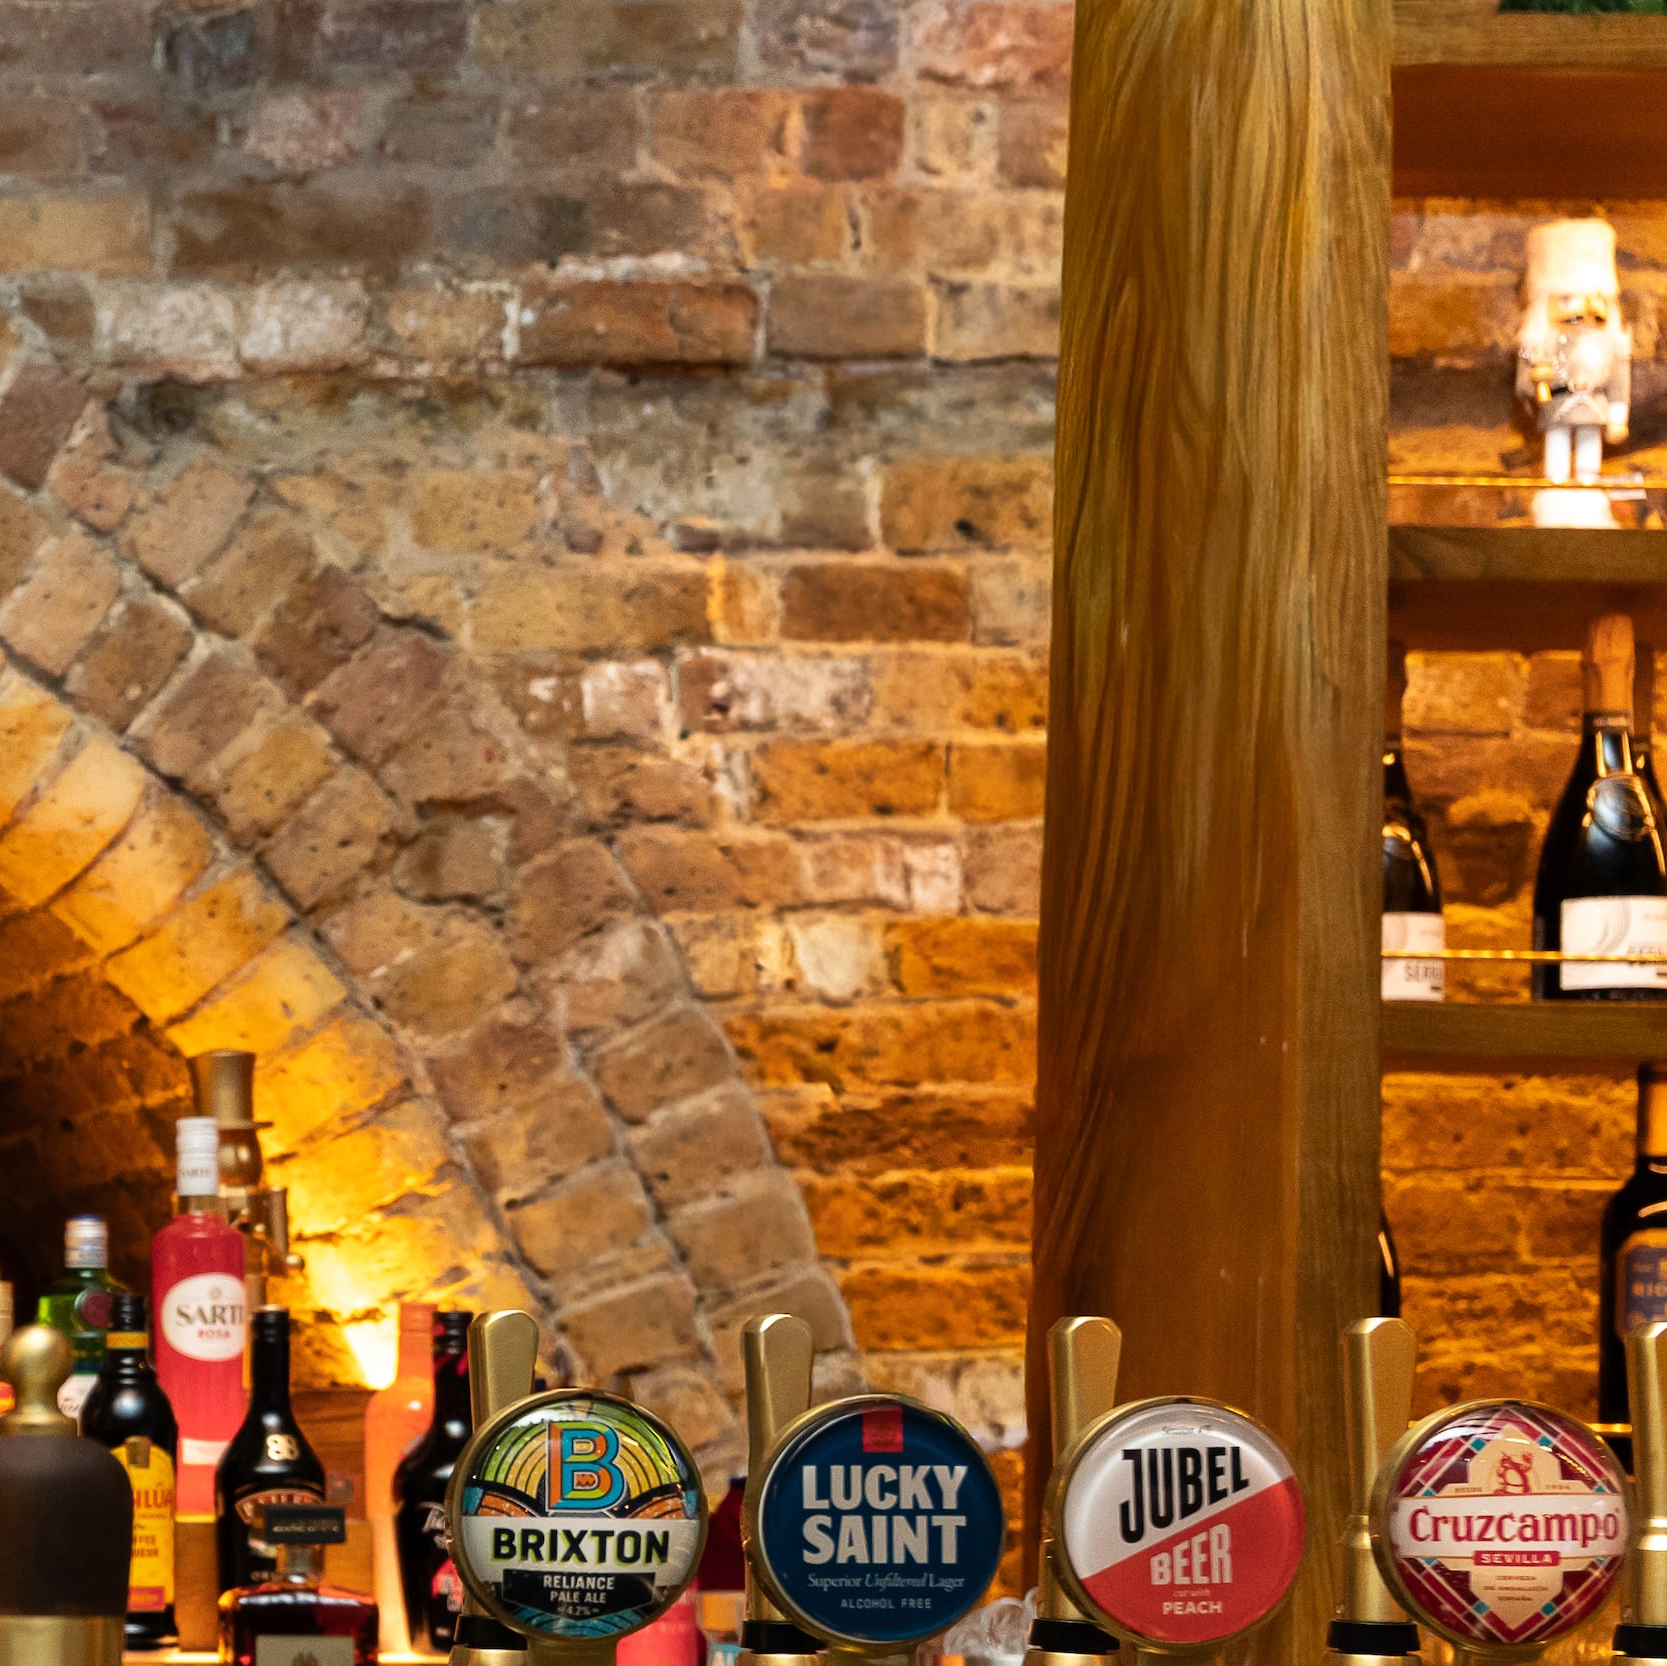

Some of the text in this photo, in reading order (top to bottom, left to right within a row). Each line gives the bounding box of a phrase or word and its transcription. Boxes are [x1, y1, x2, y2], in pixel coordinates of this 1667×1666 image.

[175, 1304, 244, 1327] SARTI
[546, 1421, 628, 1513] B
[802, 1464, 969, 1511] LUCKY
[1119, 1445, 1250, 1545] JUBEL
[801, 1514, 968, 1565] SAINT
[1407, 1506, 1620, 1549] Cruzcampo
[491, 1527, 670, 1567] BRIXTON
[1149, 1522, 1234, 1587] BEER
[1480, 1552, 1553, 1565] SEVILLA
[543, 1574, 615, 1591] RELIANCE
[550, 1590, 607, 1604] PALE ALE
[807, 1572, 966, 1592] Superior Unfiltered Lager
[840, 1597, 932, 1610] ALCOHOL FREE
[1161, 1600, 1223, 1616] PEACH
